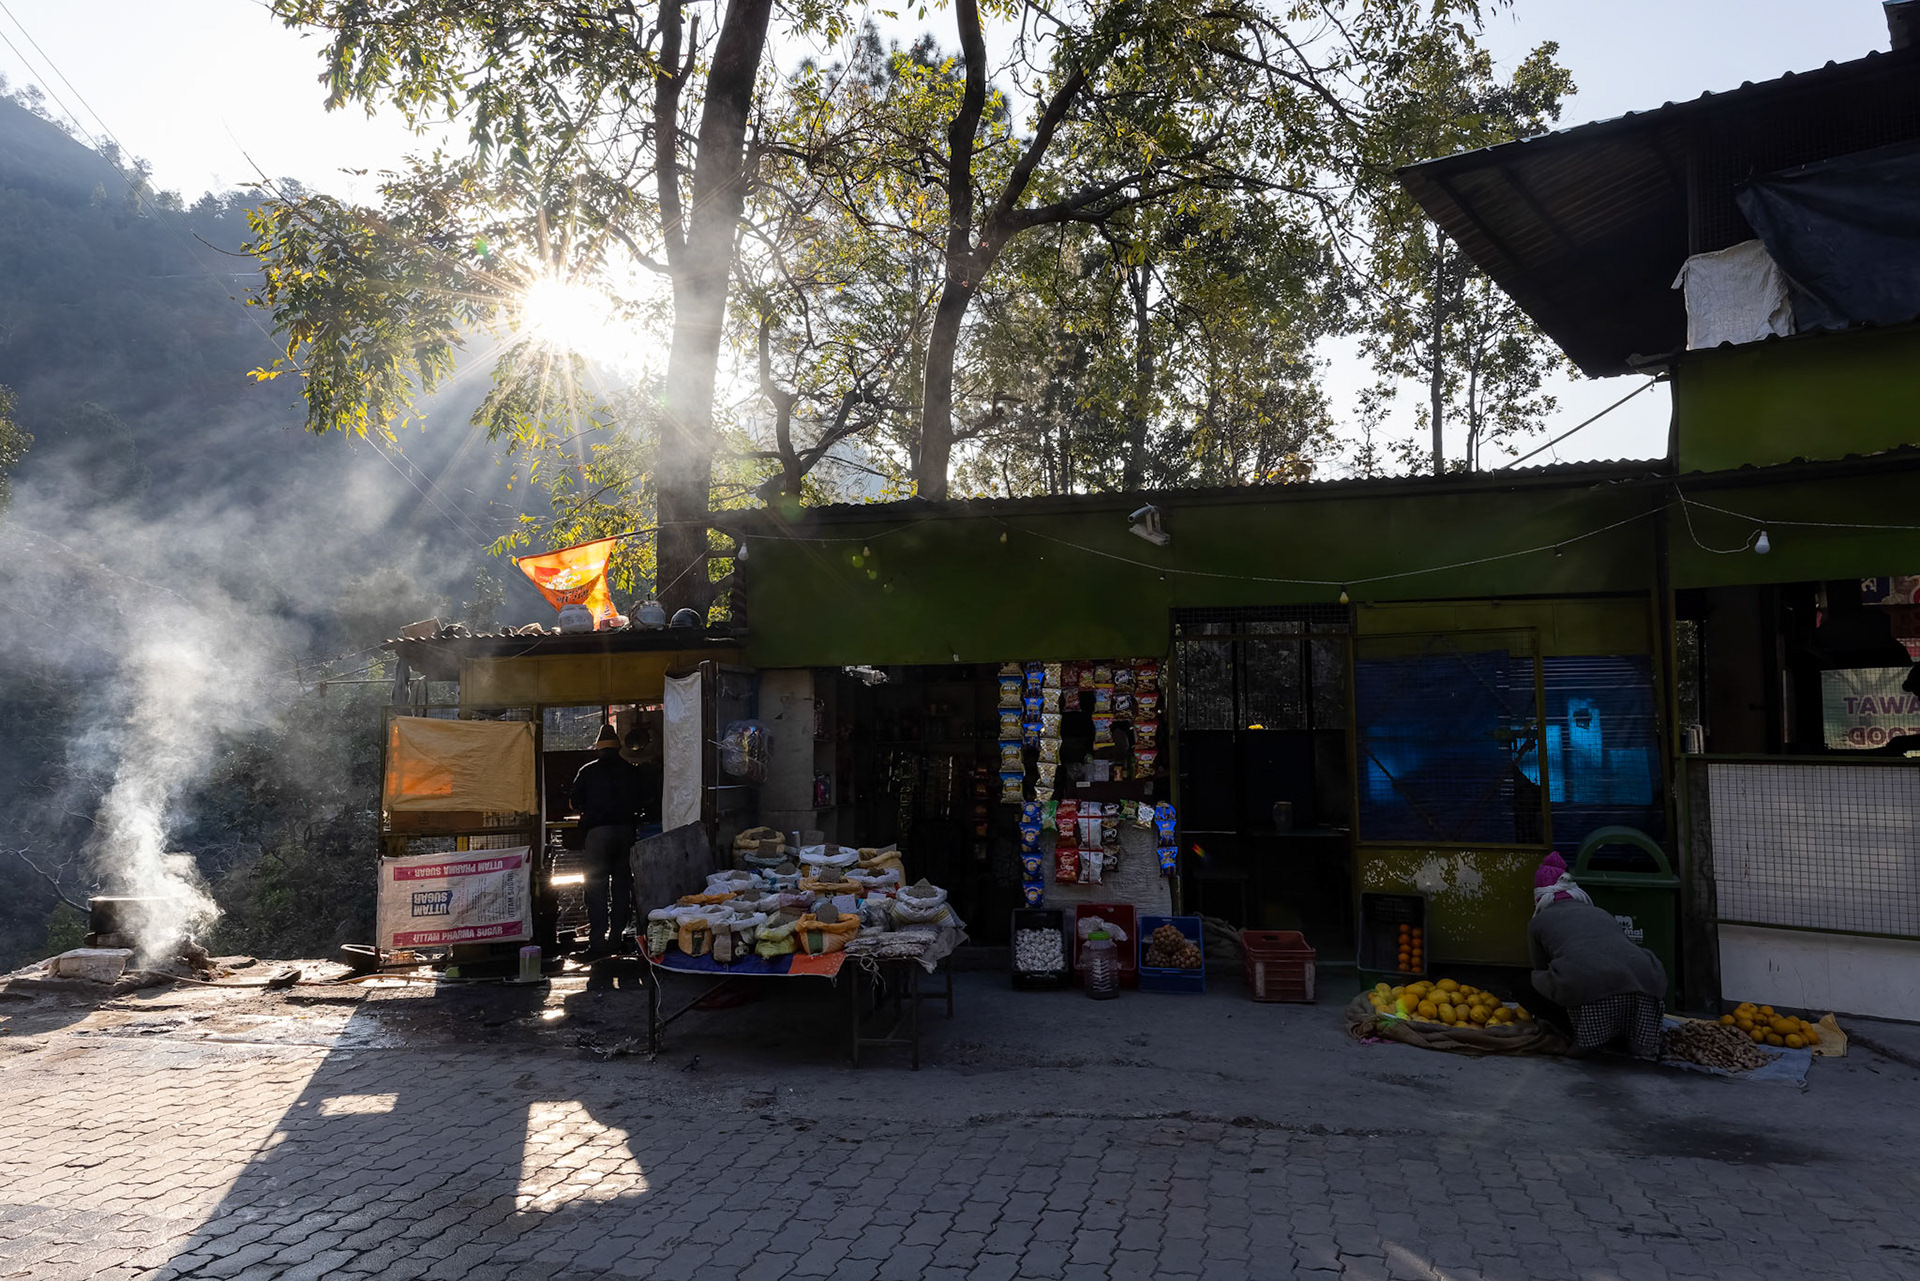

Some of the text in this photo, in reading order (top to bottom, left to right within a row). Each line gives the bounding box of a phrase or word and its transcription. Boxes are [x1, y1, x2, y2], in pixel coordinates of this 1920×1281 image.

[415, 860, 503, 877] UTTAM PHARMA SUGAR
[414, 892, 448, 904] SUGAR
[414, 903, 447, 916] UTTAM
[413, 926, 503, 943] UTTAM PHARMA SUGAR
